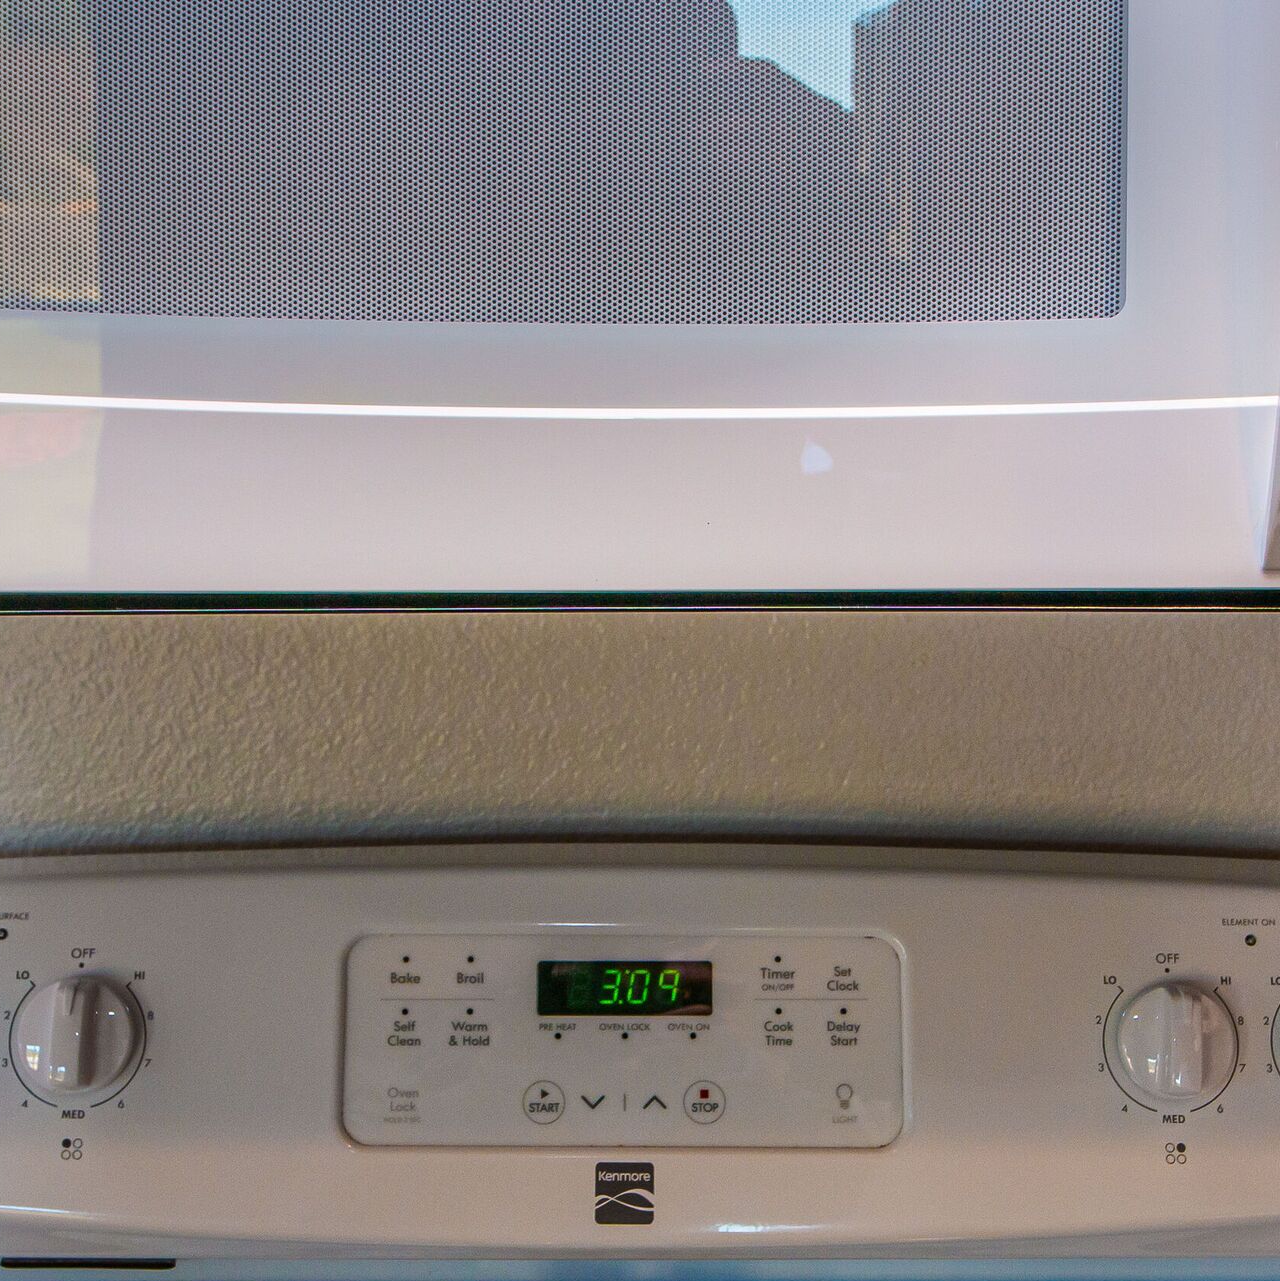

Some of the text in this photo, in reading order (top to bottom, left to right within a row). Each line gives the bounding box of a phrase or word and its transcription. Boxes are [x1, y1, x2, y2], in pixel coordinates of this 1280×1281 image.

[1221, 918, 1276, 926] ELEMENT ON
[71, 948, 96, 959] OFF
[1155, 953, 1180, 964] OFF
[16, 971, 30, 980] LO
[134, 971, 146, 980] HI
[760, 968, 795, 979] Timer
[833, 966, 851, 977] Set
[390, 972, 420, 984] Bake
[456, 972, 484, 984] Broil
[1103, 976, 1117, 985] LO
[1220, 976, 1232, 985] HI
[599, 969, 680, 1004] 3:09
[761, 984, 794, 992] ON/OFF
[826, 980, 859, 992] Clock
[3, 1011, 10, 1020] 2
[147, 1011, 154, 1021] 8
[1095, 1015, 1102, 1024] 2
[452, 1021, 488, 1031] Warm
[1238, 1016, 1245, 1026] 8
[1263, 1016, 1270, 1026] 2
[393, 1021, 416, 1032] Self
[599, 1023, 624, 1031] OVEN
[668, 1023, 693, 1031] OVEN
[764, 1021, 793, 1032] Cook
[827, 1021, 860, 1033] Delay
[387, 1035, 421, 1047] Clean
[449, 1035, 490, 1046] & Hold
[765, 1036, 793, 1046] Time
[830, 1035, 857, 1046] Start
[1, 1058, 9, 1068] 3
[145, 1059, 152, 1068] 7
[1098, 1063, 1105, 1072] 3
[1266, 1063, 1273, 1073] 3
[1239, 1064, 1246, 1073] 7
[20, 1100, 28, 1109] 4
[117, 1099, 125, 1109] 6
[390, 1101, 416, 1112] Lock
[528, 1103, 560, 1113] START
[692, 1103, 718, 1112] STOP
[1121, 1104, 1128, 1113] 4
[1217, 1104, 1224, 1113] 6
[61, 1110, 85, 1120] MED
[1162, 1115, 1186, 1124] MED
[598, 1171, 651, 1182] Kenmore
